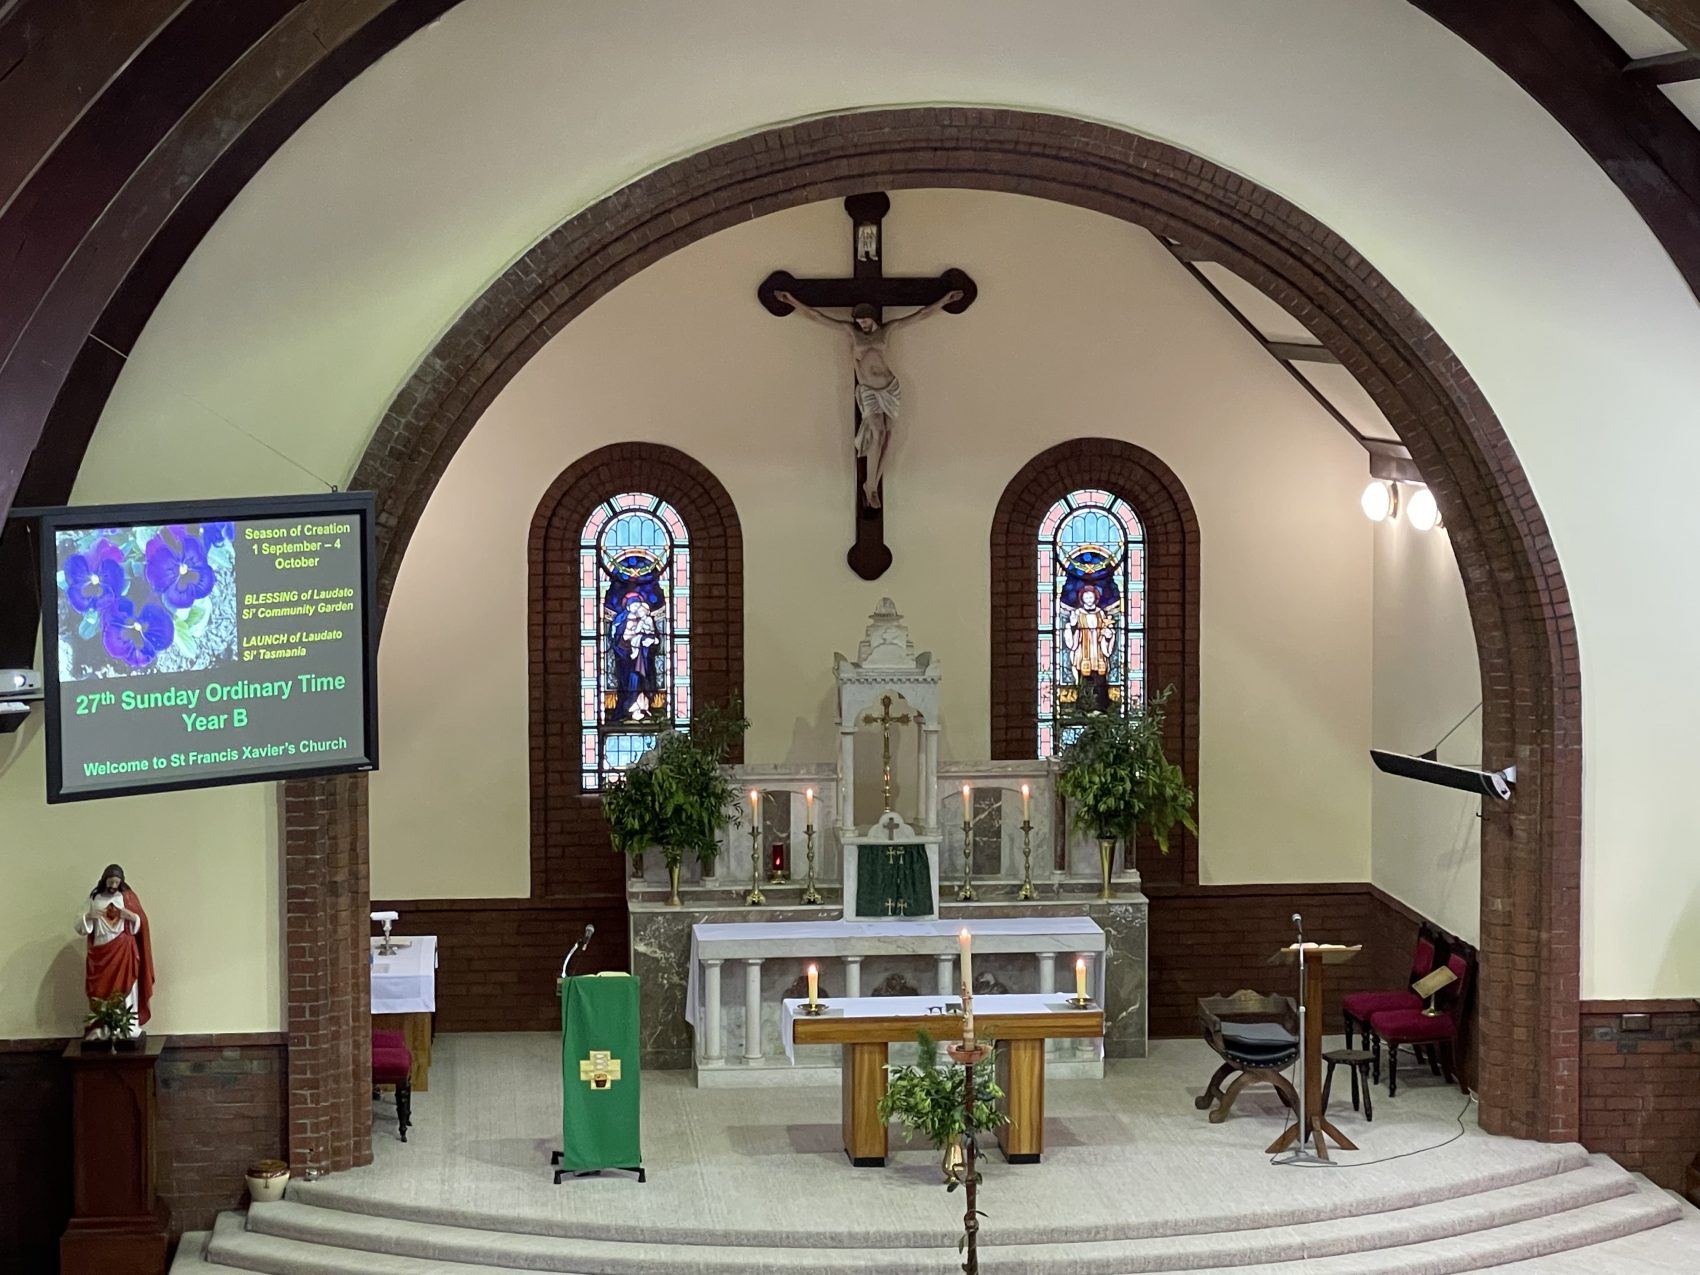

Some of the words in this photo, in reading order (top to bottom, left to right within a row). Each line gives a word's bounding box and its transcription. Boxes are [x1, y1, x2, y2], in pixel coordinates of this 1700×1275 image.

[245, 528, 286, 540] Season
[290, 525, 301, 536] of
[304, 523, 350, 535] Creation
[252, 544, 258, 555] 1
[262, 541, 321, 555] September
[334, 538, 341, 548] 4
[275, 557, 320, 569] October
[244, 591, 298, 604] BLESSING
[301, 590, 312, 600] of
[314, 588, 354, 599] Laudato
[258, 604, 315, 618] Community
[318, 602, 354, 613] Garden
[243, 634, 287, 647] LAUNCH
[290, 632, 301, 643] of
[302, 630, 342, 642] Laudato
[260, 646, 306, 660] Tasmania
[76, 691, 115, 715] 27th
[121, 687, 200, 710] Sunday
[206, 679, 293, 703] Ordinary
[298, 674, 345, 693] Time
[182, 712, 228, 732] Year
[233, 708, 248, 727] B
[84, 757, 148, 776] Welcome
[153, 757, 167, 769] to
[170, 753, 185, 767] St
[189, 749, 239, 765] Francis
[300, 737, 347, 753] Church
